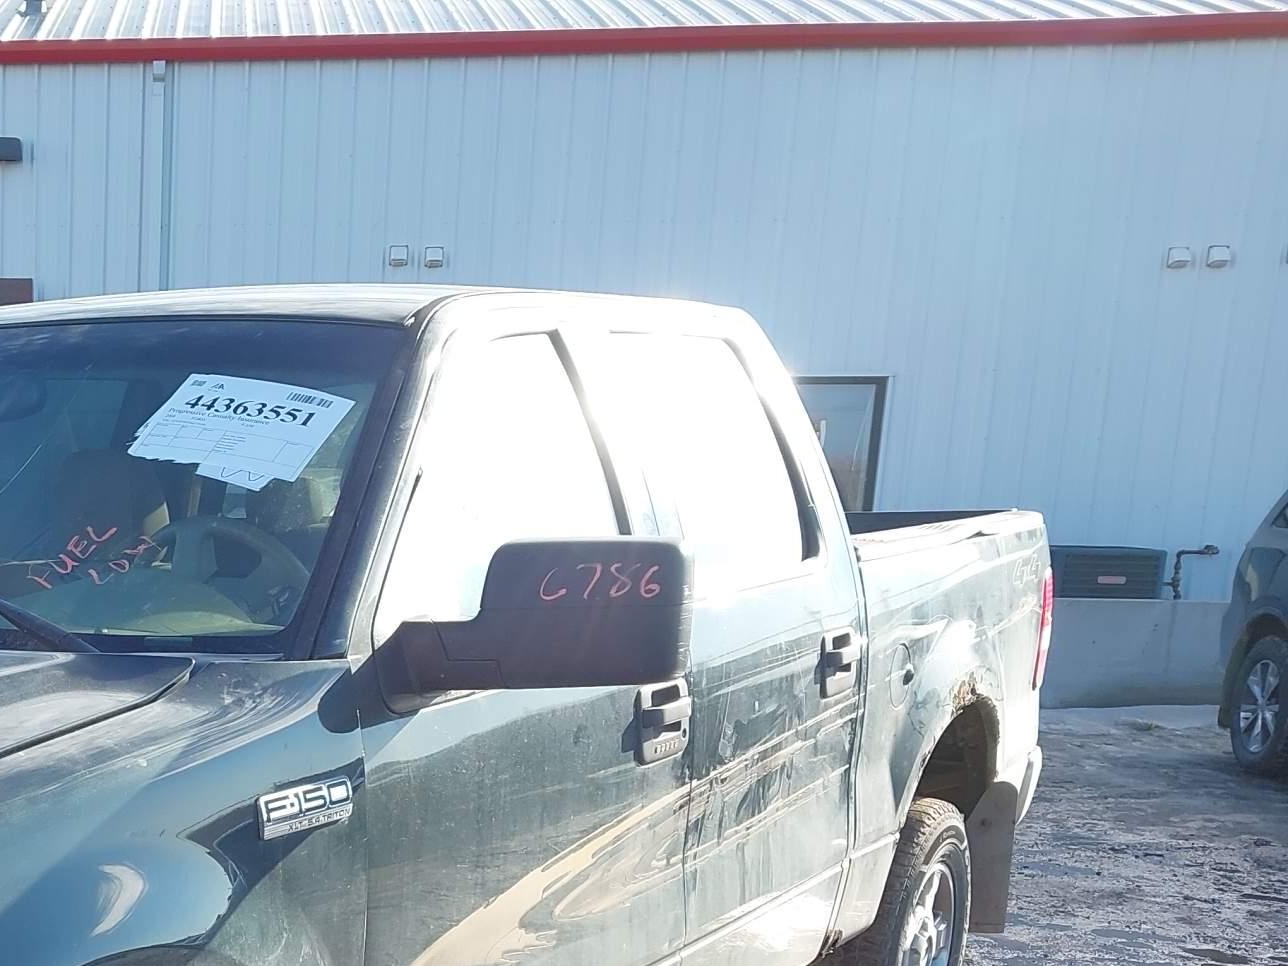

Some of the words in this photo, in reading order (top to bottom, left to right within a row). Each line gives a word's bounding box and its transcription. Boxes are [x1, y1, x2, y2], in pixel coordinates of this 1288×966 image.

[168, 407, 207, 418] Progressive
[207, 411, 236, 422] Casualty
[237, 415, 271, 426] Insurance
[184, 394, 317, 428] 44363551
[26, 526, 119, 590] FUEL
[539, 562, 661, 601] 6786
